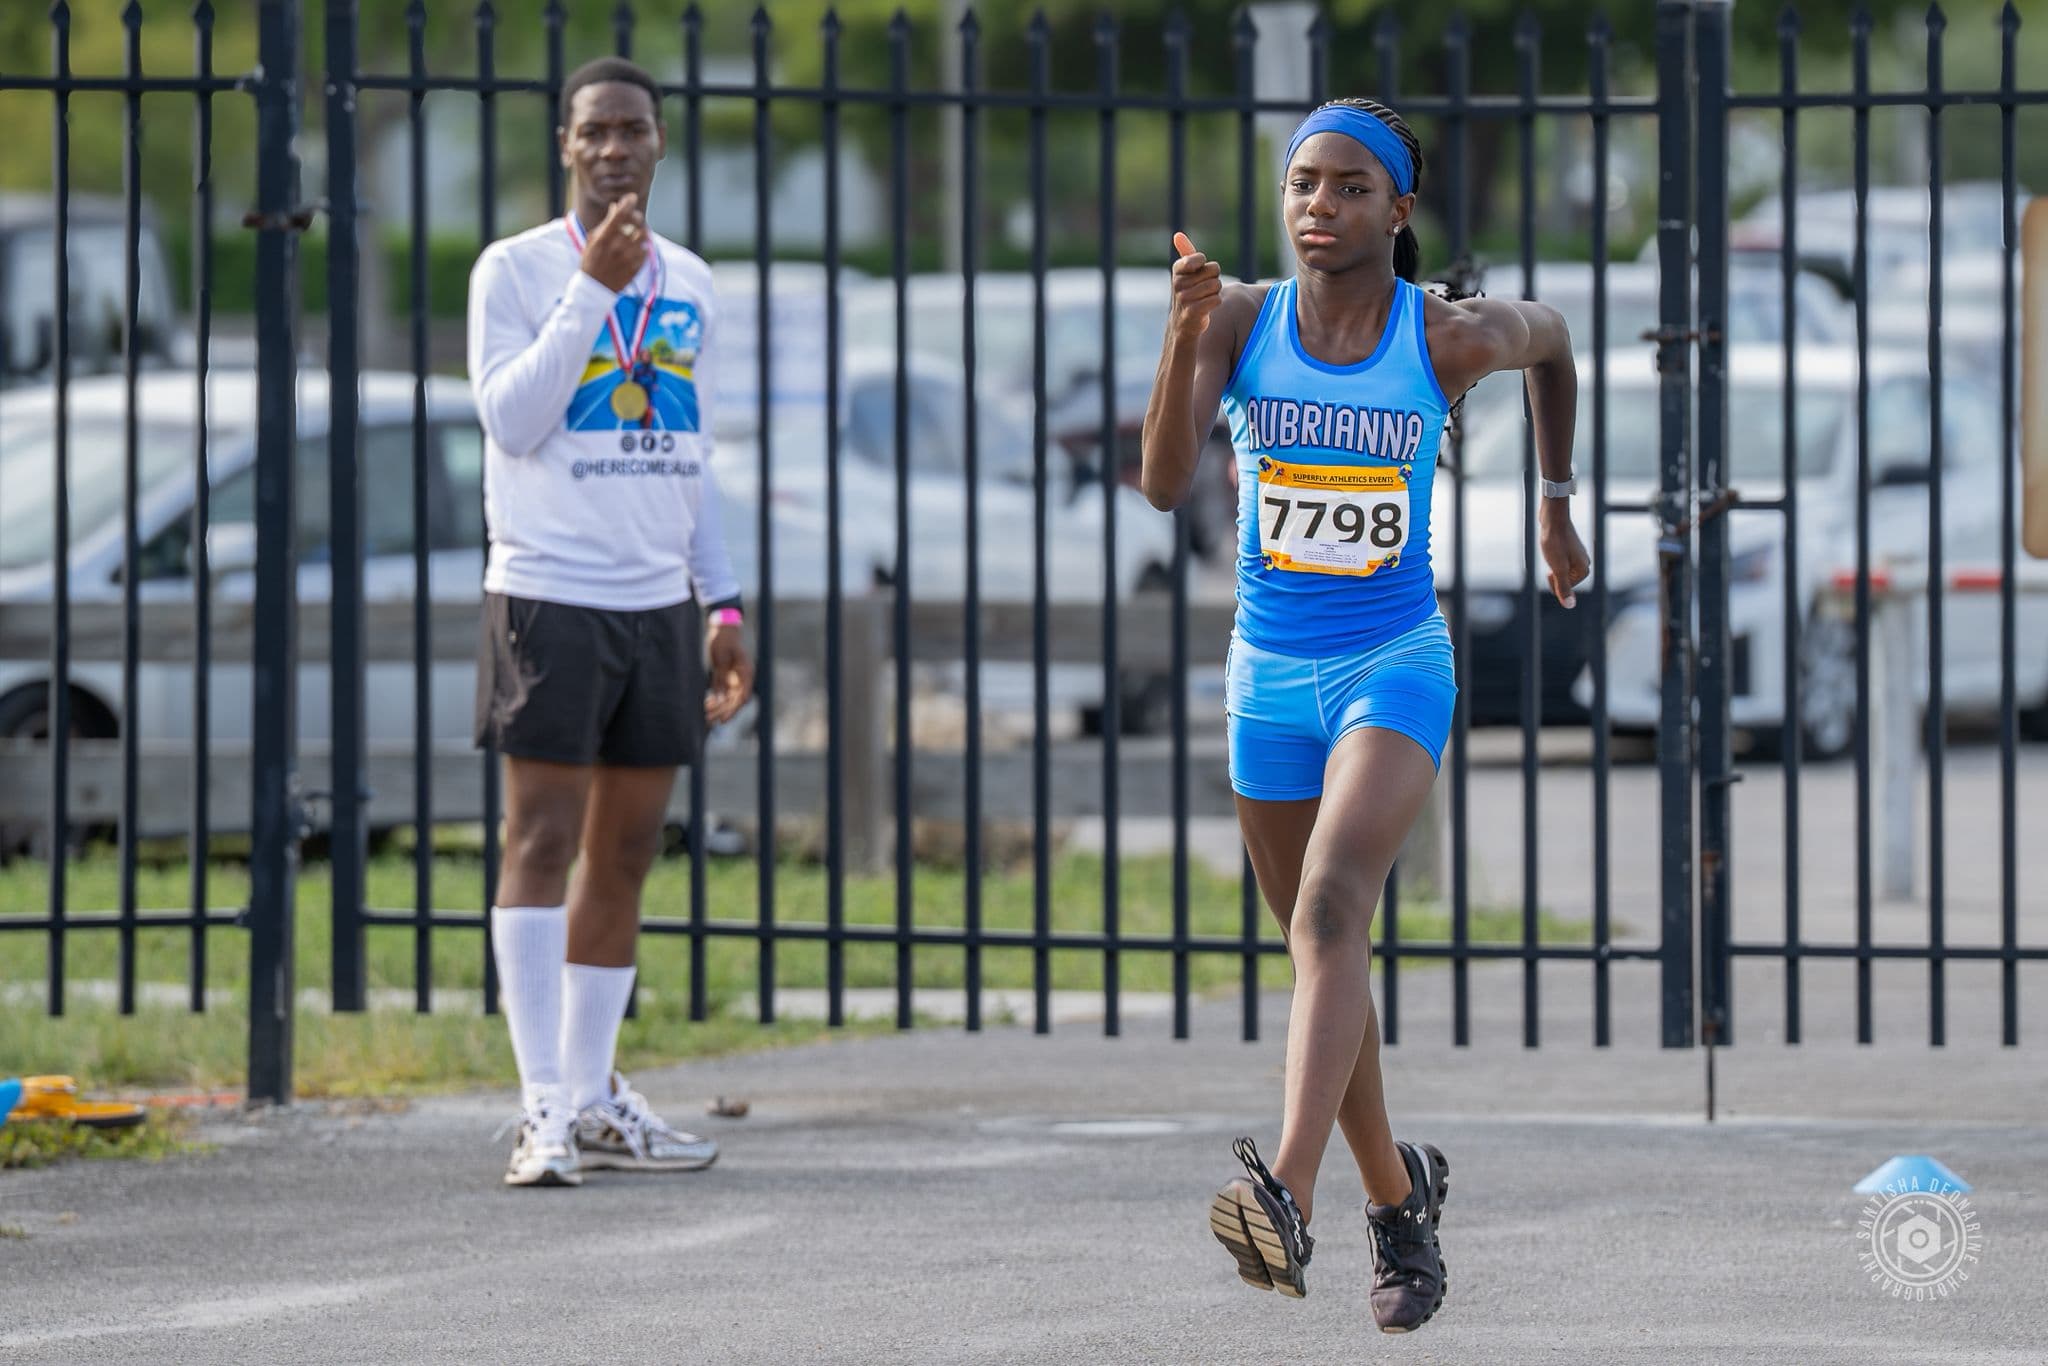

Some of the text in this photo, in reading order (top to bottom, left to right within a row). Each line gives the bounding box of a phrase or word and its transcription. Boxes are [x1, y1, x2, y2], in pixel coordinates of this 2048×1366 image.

[1247, 398, 1424, 461] AUBRIANNA
[1292, 473, 1394, 484] SUPERFLY ATHLETICS EVENTS
[1264, 496, 1402, 548] 7798
